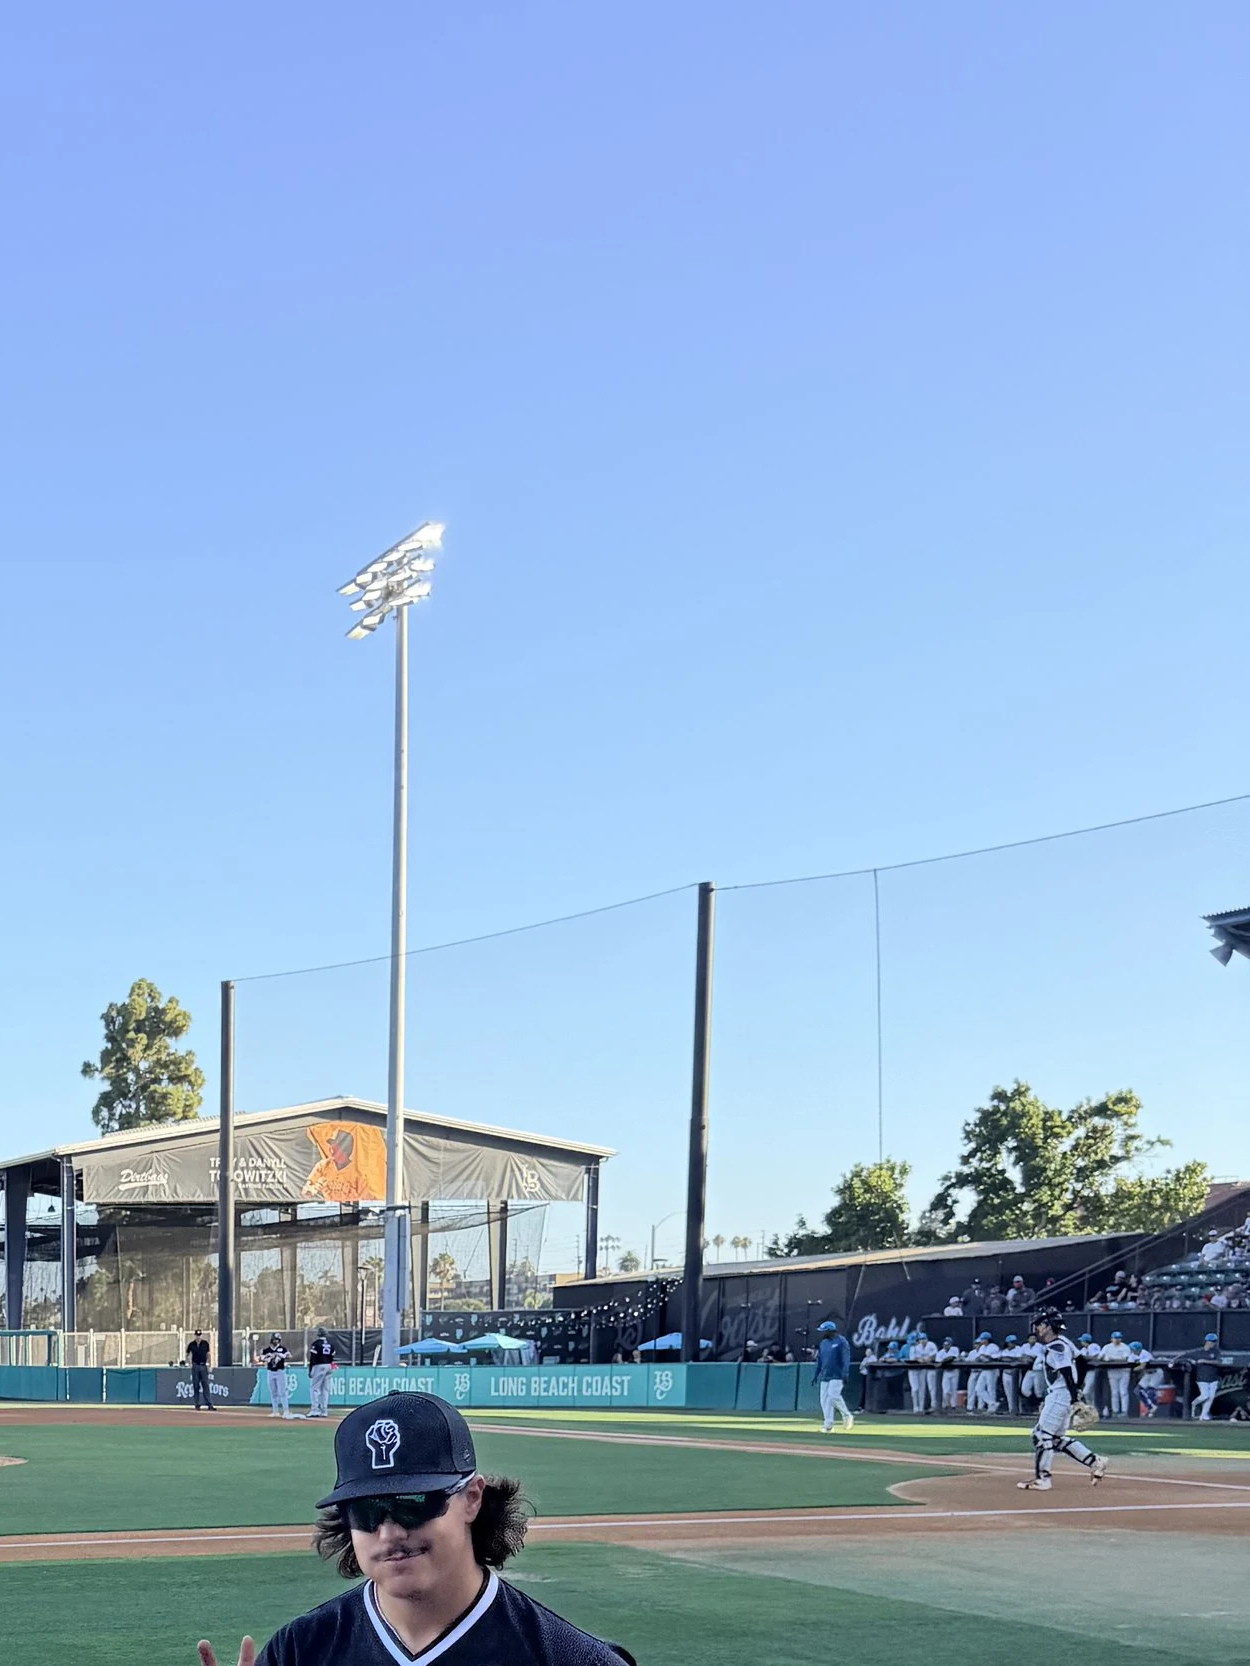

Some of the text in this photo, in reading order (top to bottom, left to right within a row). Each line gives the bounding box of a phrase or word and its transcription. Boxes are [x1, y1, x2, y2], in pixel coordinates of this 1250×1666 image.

[209, 1170, 287, 1183] TOWITZKI
[349, 1377, 389, 1396] BEACH
[393, 1377, 434, 1394] COAST
[490, 1375, 631, 1397] LONG BEACH COAST
